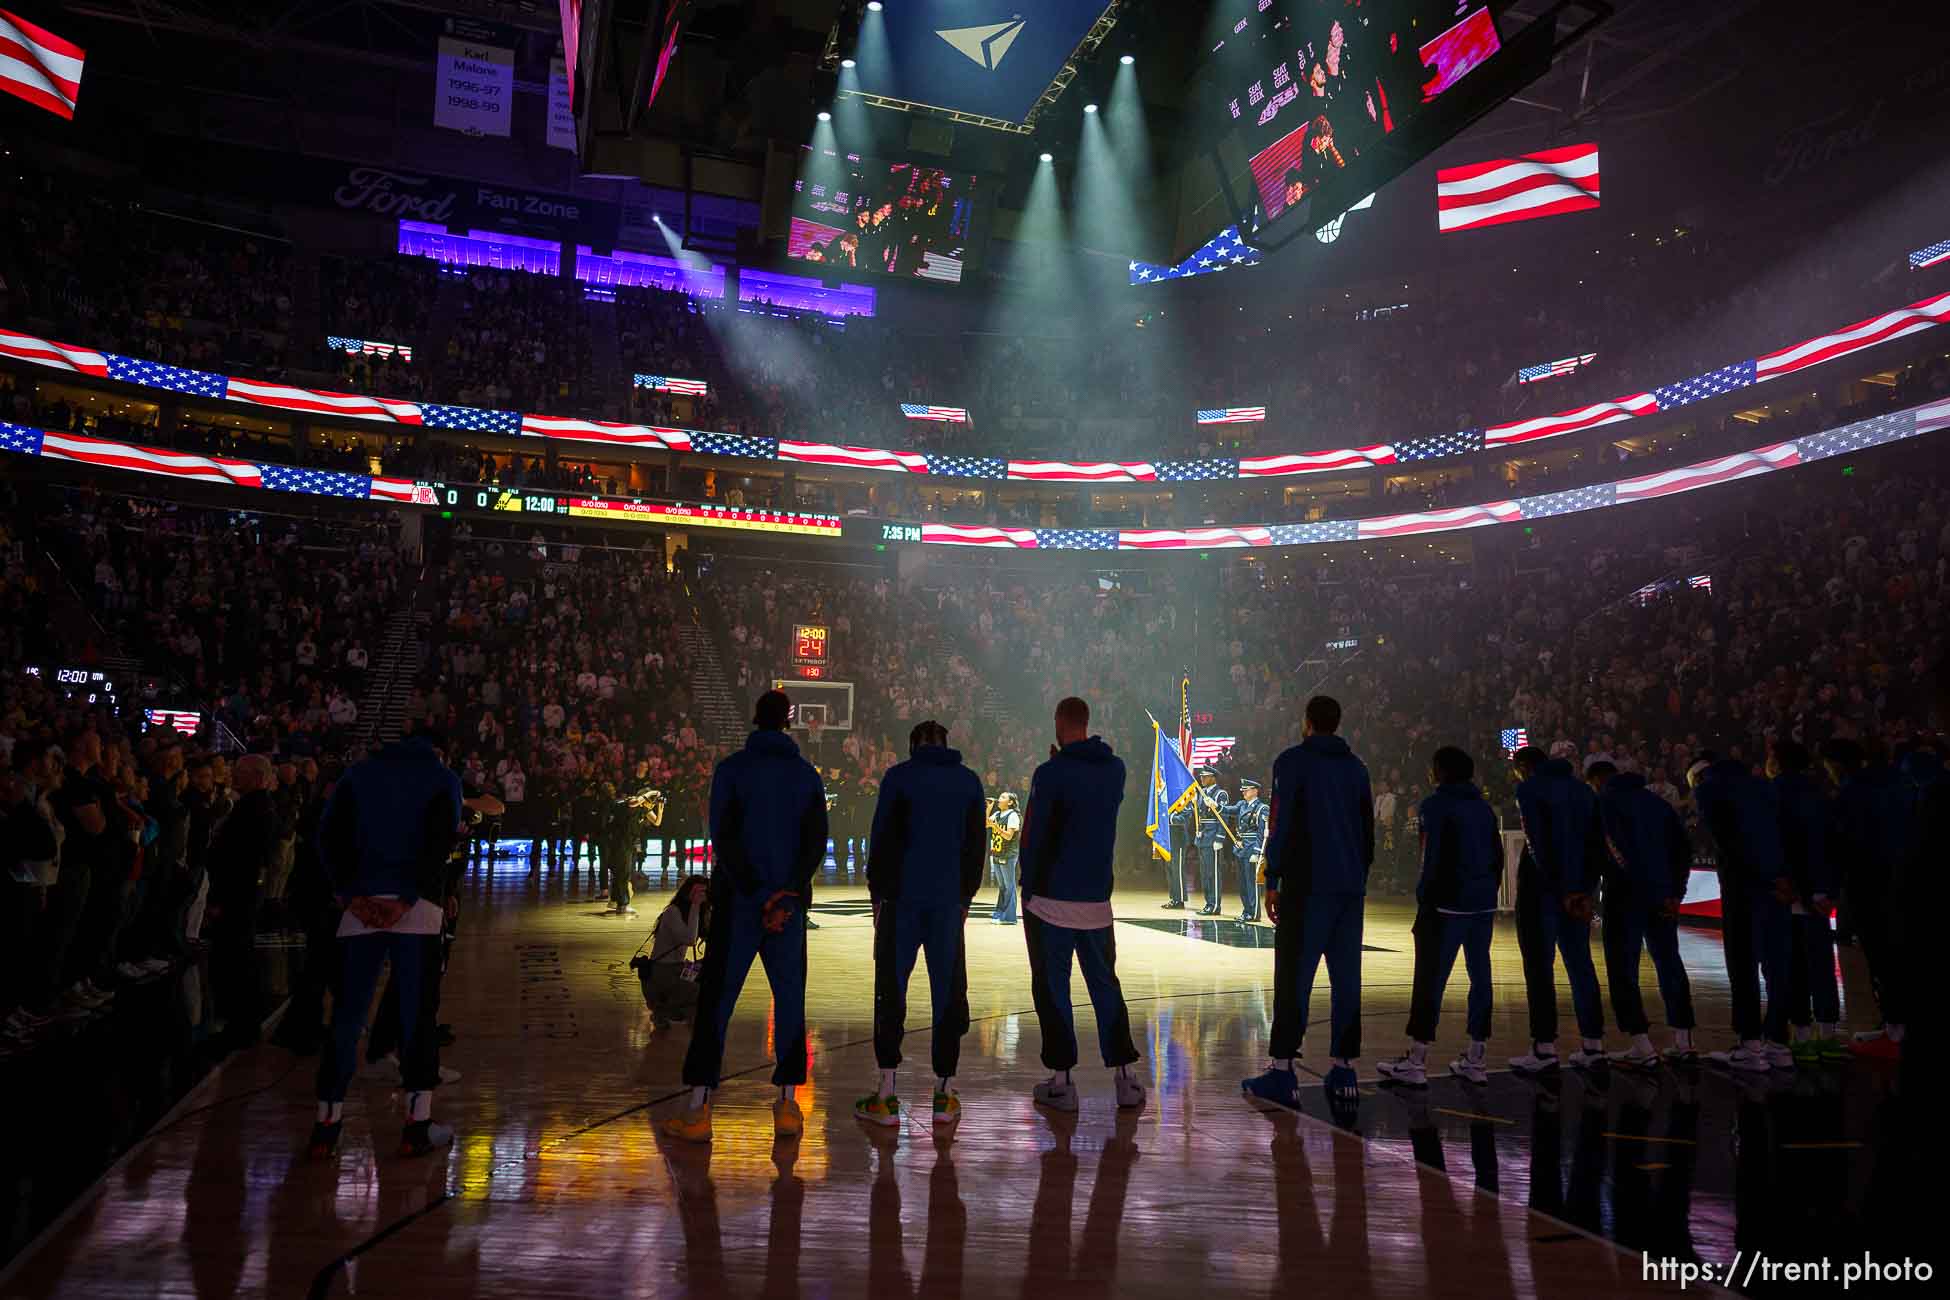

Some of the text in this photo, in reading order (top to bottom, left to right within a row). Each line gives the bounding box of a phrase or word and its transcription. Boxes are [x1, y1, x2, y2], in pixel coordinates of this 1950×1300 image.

[1234, 17, 1248, 34] GEEK
[464, 48, 489, 61] Karl
[453, 61, 498, 77] Malone
[1273, 62, 1287, 80] SEAT
[447, 79, 501, 96] 1996-97
[1248, 80, 1262, 97] SEAT
[1274, 72, 1291, 89] GEEK
[447, 95, 501, 112] 1998-99
[1249, 90, 1265, 106] GEEK
[334, 167, 579, 221] Ford Fan Zone
[447, 490, 457, 504] 0
[477, 492, 487, 507] 0
[525, 496, 555, 512] 12:00
[883, 525, 921, 541] 7:35 PM
[800, 628, 825, 639] 12:00
[800, 639, 822, 656] 24
[58, 669, 87, 683] 12:00
[105, 682, 112, 692] 0
[89, 694, 96, 703] 0
